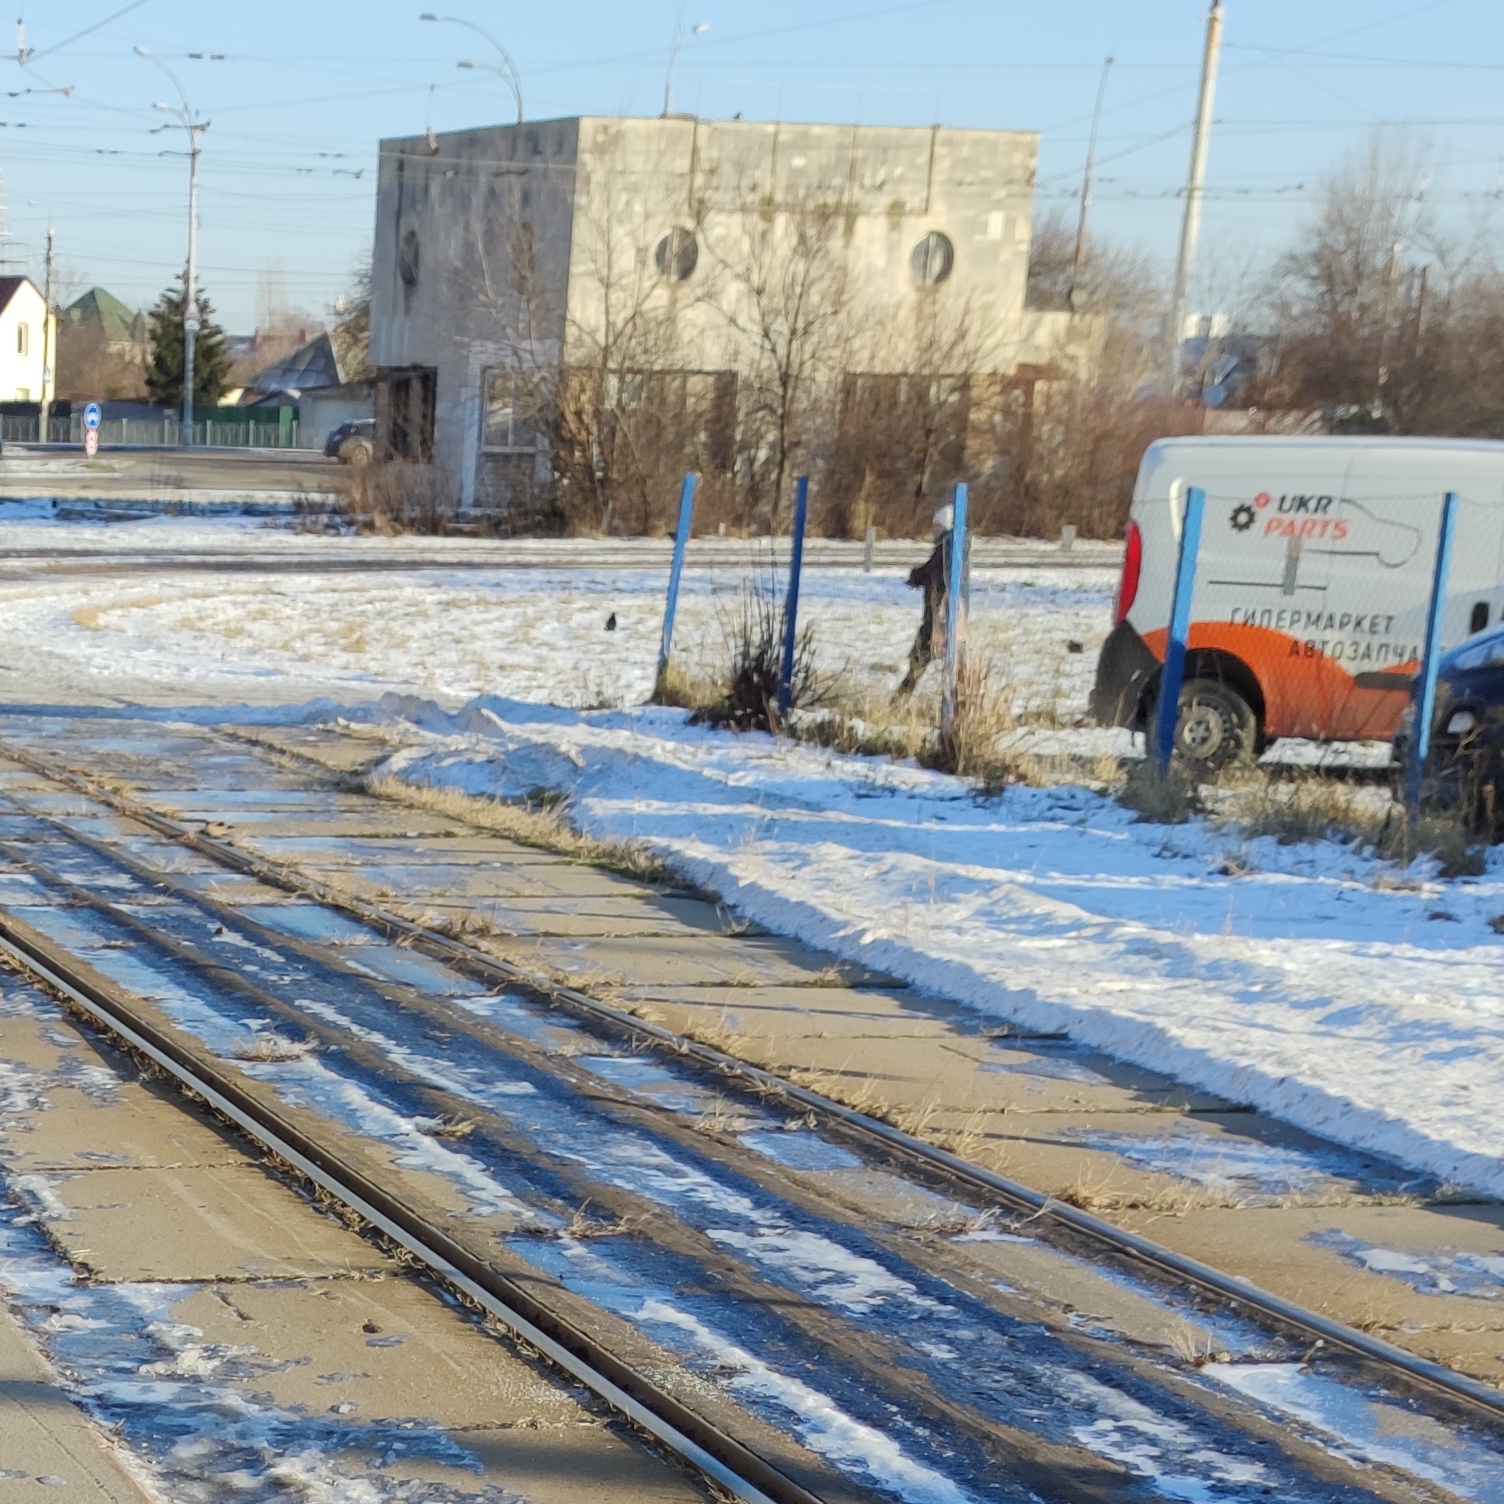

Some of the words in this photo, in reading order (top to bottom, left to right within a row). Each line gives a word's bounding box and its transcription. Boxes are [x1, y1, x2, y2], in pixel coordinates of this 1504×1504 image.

[1277, 494, 1333, 514] UKR
[1264, 517, 1349, 539] PARTS
[1229, 607, 1396, 636] ГИПЕРМАРКЕТ
[1287, 639, 1445, 663] АВТОЗАПЧА
